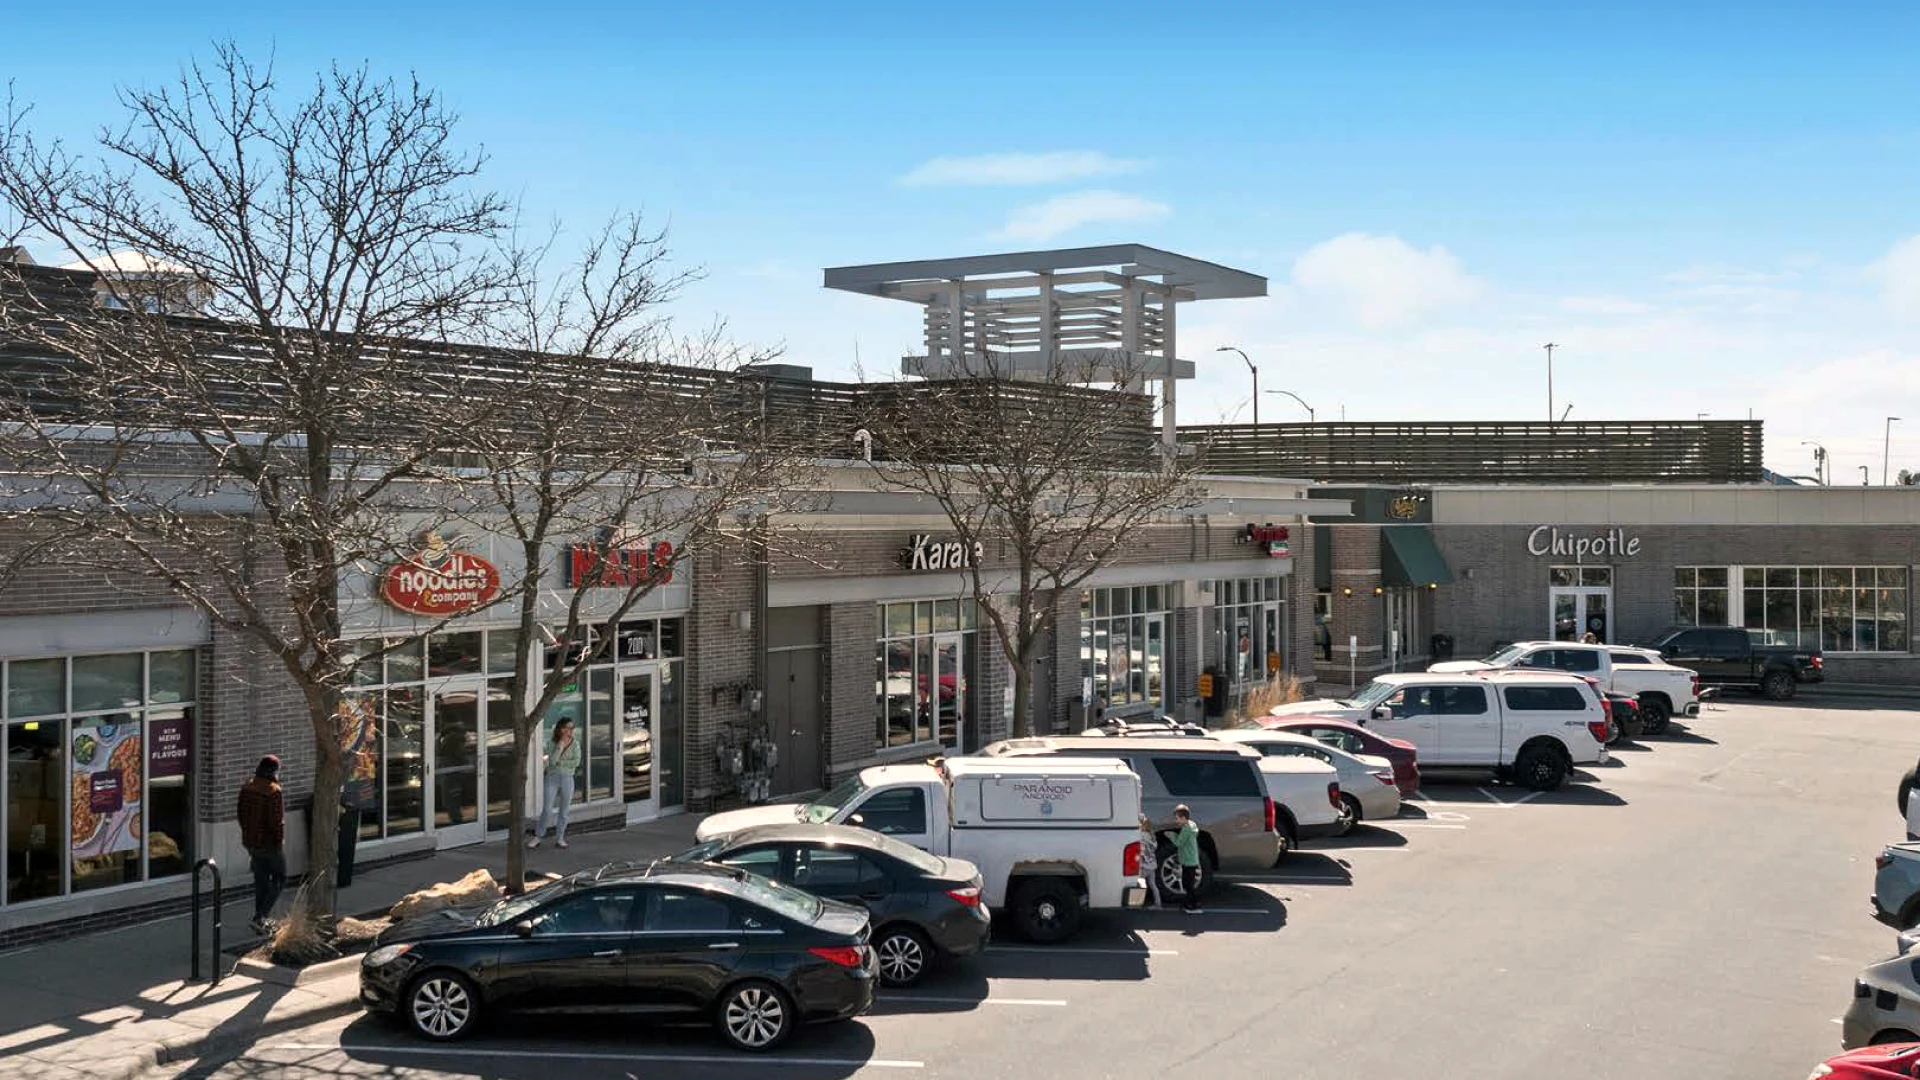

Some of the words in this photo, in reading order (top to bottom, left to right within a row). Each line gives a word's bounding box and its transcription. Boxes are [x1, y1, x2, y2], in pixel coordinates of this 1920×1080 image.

[1527, 525, 1641, 563] Chipotle
[399, 555, 488, 593] noodles
[431, 591, 480, 607] company
[158, 733, 181, 742] MENU
[151, 749, 188, 759] FLAVORS
[1014, 783, 1073, 794] PARANOID
